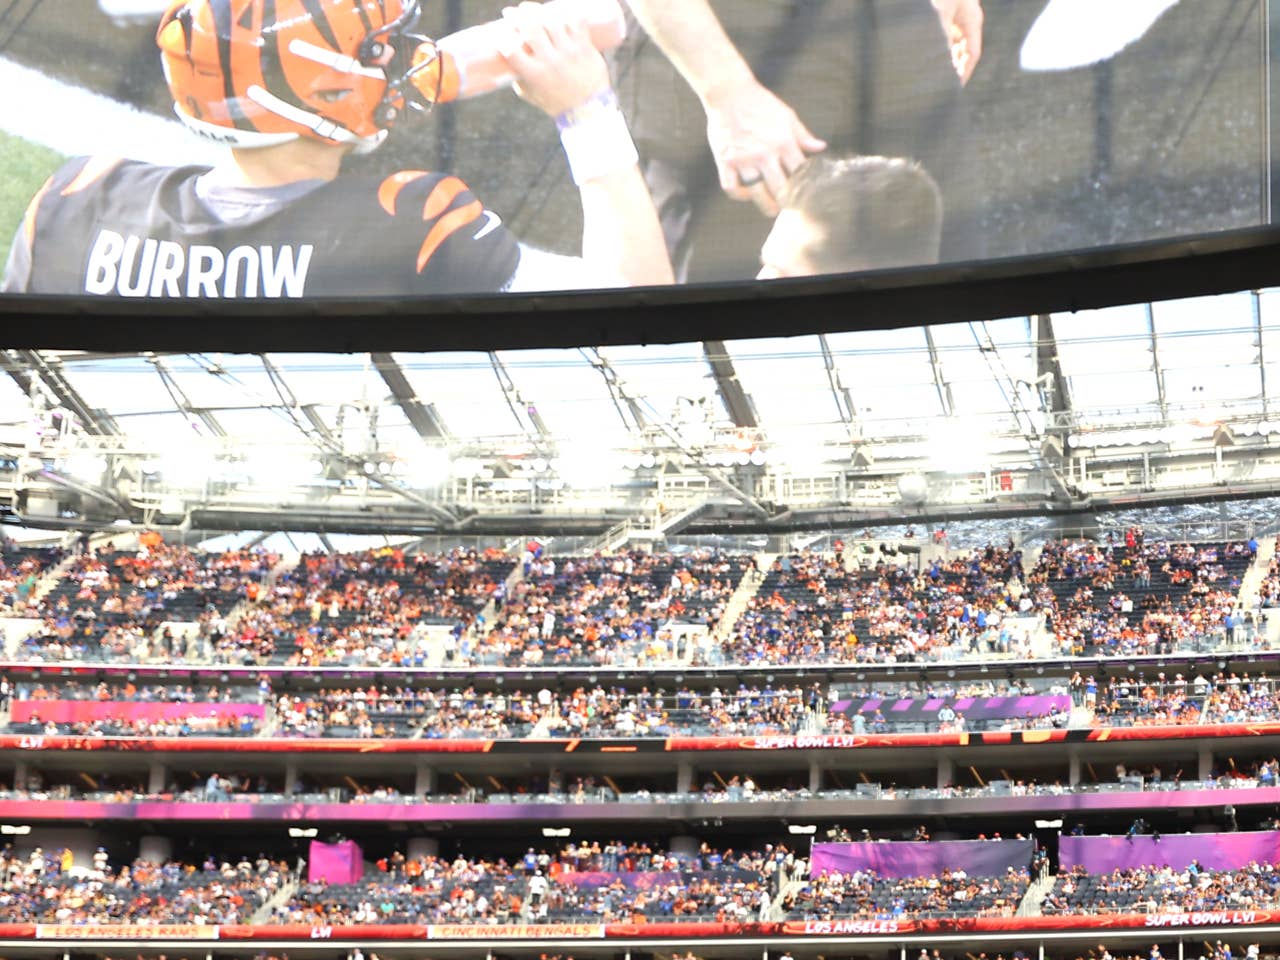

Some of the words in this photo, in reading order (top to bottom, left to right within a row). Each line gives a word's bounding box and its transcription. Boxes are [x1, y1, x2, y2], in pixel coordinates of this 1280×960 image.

[85, 229, 314, 298] BURROW
[754, 737, 794, 748] SUPER
[796, 736, 832, 748] BOWL
[833, 736, 855, 747] LVI
[1145, 913, 1190, 926] SUPER
[1191, 912, 1231, 925] BOWL
[1233, 911, 1256, 923] LVI
[310, 926, 332, 938] LVI
[442, 926, 522, 937] CINCINNATI
[525, 925, 592, 937] BENGALS
[805, 921, 832, 934] LOS
[834, 920, 899, 933] ANGELES
